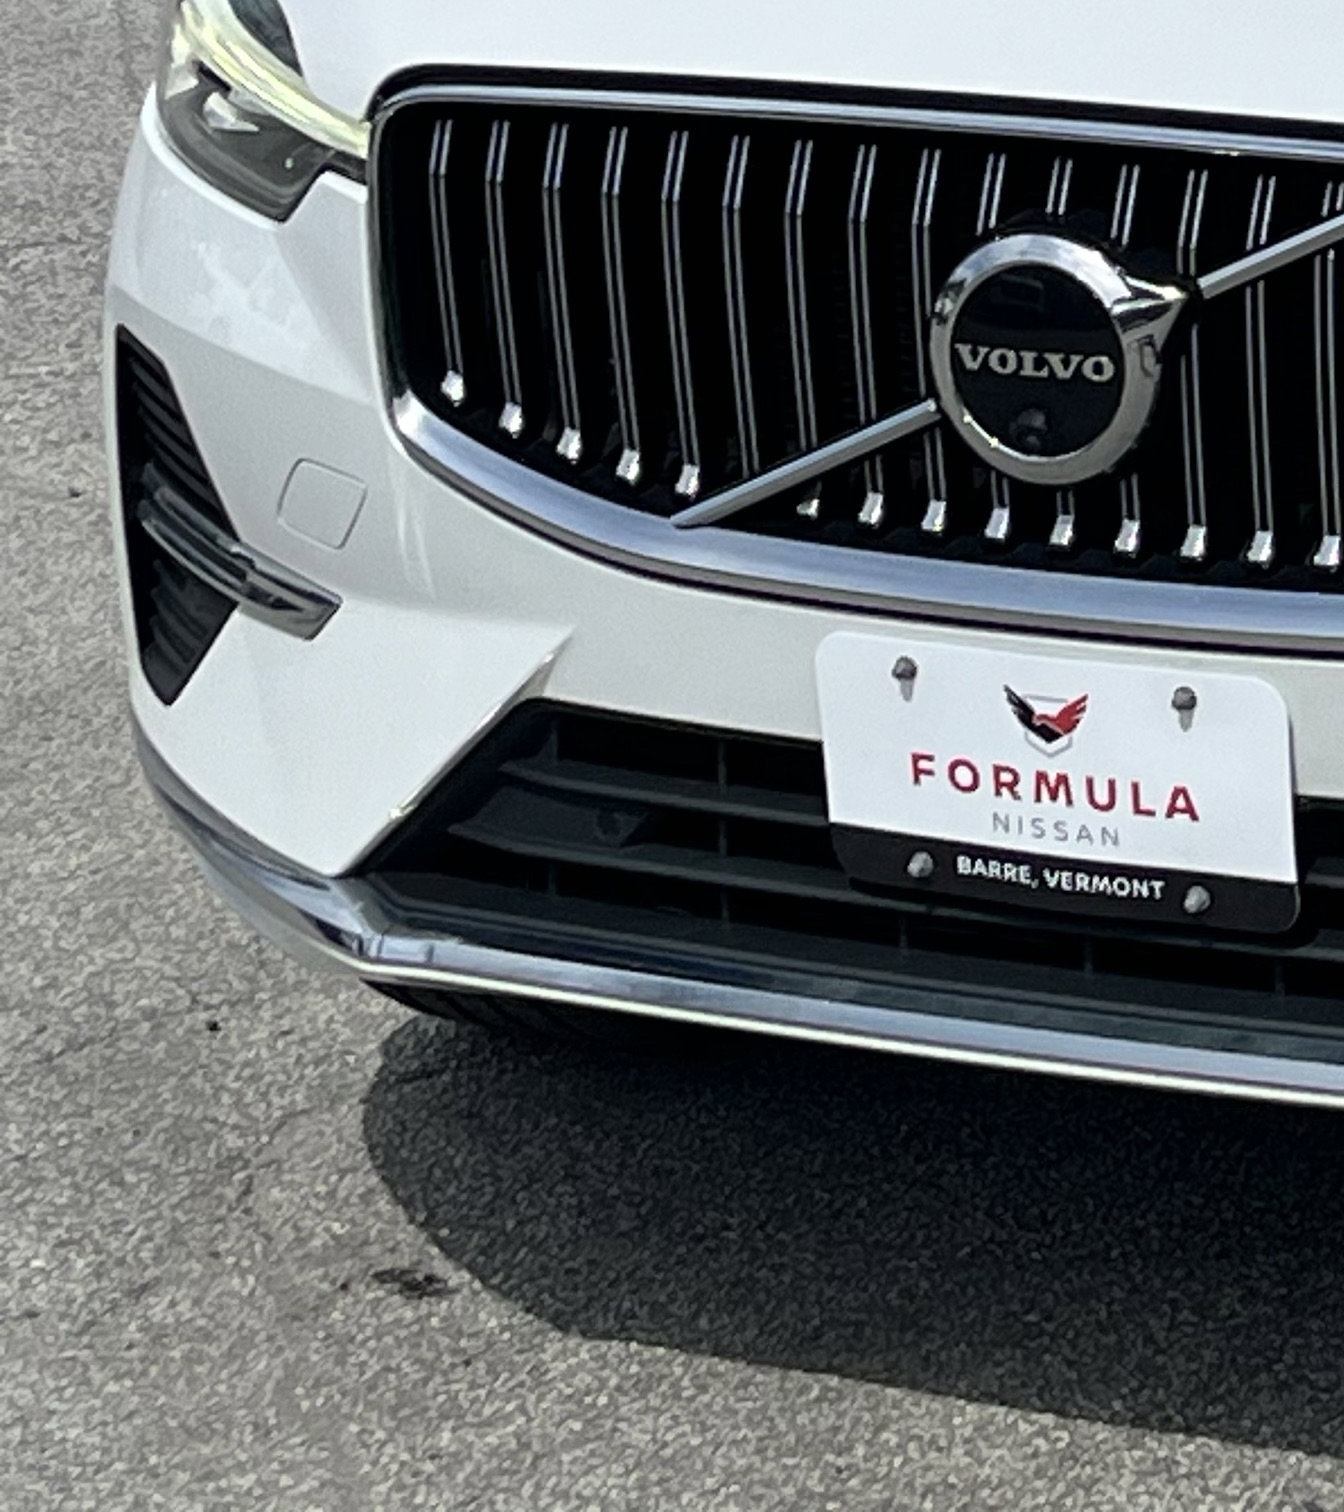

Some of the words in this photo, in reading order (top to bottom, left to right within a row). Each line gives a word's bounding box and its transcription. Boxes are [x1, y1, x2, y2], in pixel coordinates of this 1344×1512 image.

[954, 343, 1115, 382] VOLVO
[911, 751, 1200, 822] FORMULA
[992, 812, 1120, 847] NISSAN
[957, 854, 1039, 888] BARRE,
[1043, 867, 1165, 900] VERMONT
